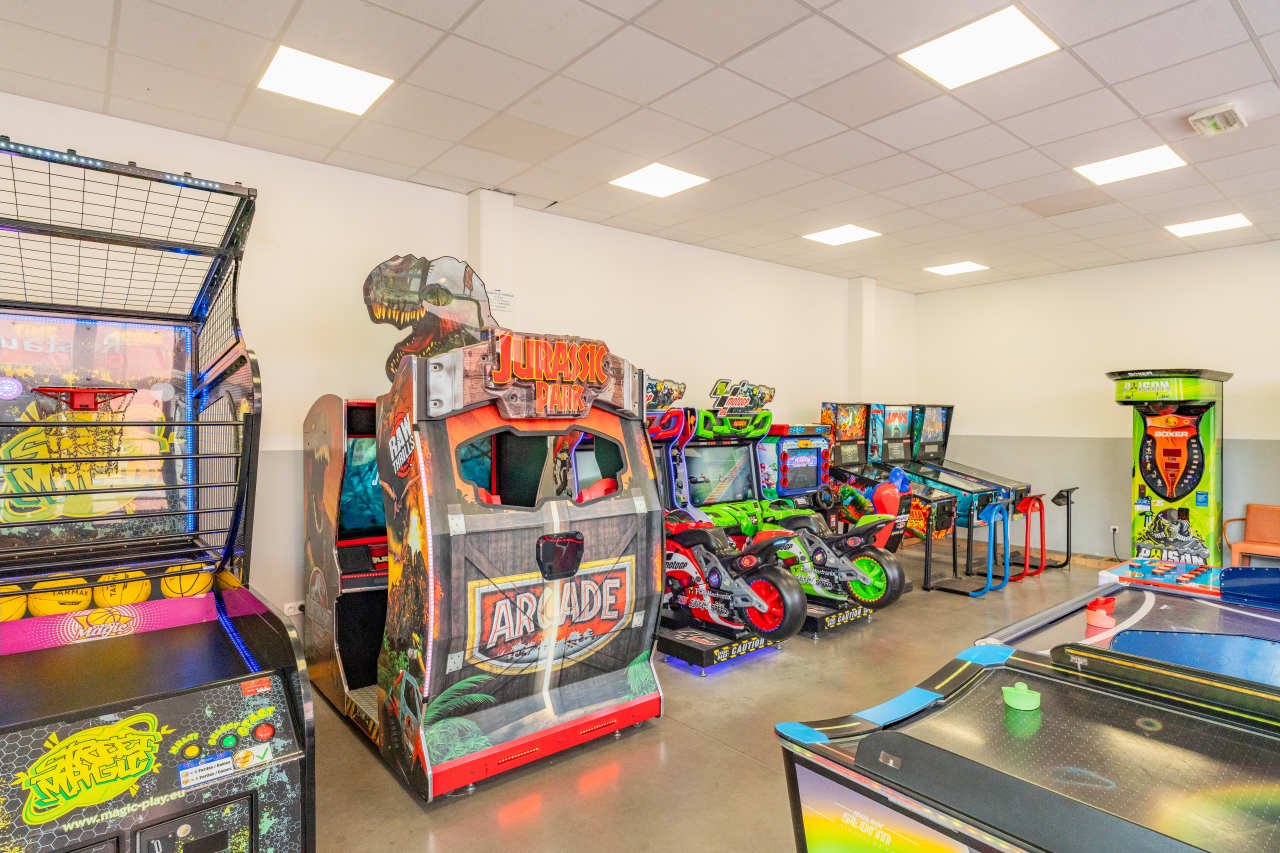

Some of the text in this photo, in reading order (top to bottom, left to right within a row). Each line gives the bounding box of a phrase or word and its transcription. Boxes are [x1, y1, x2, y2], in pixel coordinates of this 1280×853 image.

[491, 334, 608, 384] JURASSIC
[535, 381, 585, 413] PARK
[885, 411, 908, 424] JAWS
[388, 412, 412, 462] RAW
[392, 433, 415, 475] THRILLS
[76, 622, 131, 641] Magic
[486, 578, 620, 650] ARCADE
[837, 608, 862, 623] CAUTION
[731, 637, 765, 655] CAUTION
[34, 734, 160, 777] STREET
[29, 752, 154, 802] MAGIC
[62, 790, 186, 833] www.magic-play.eu
